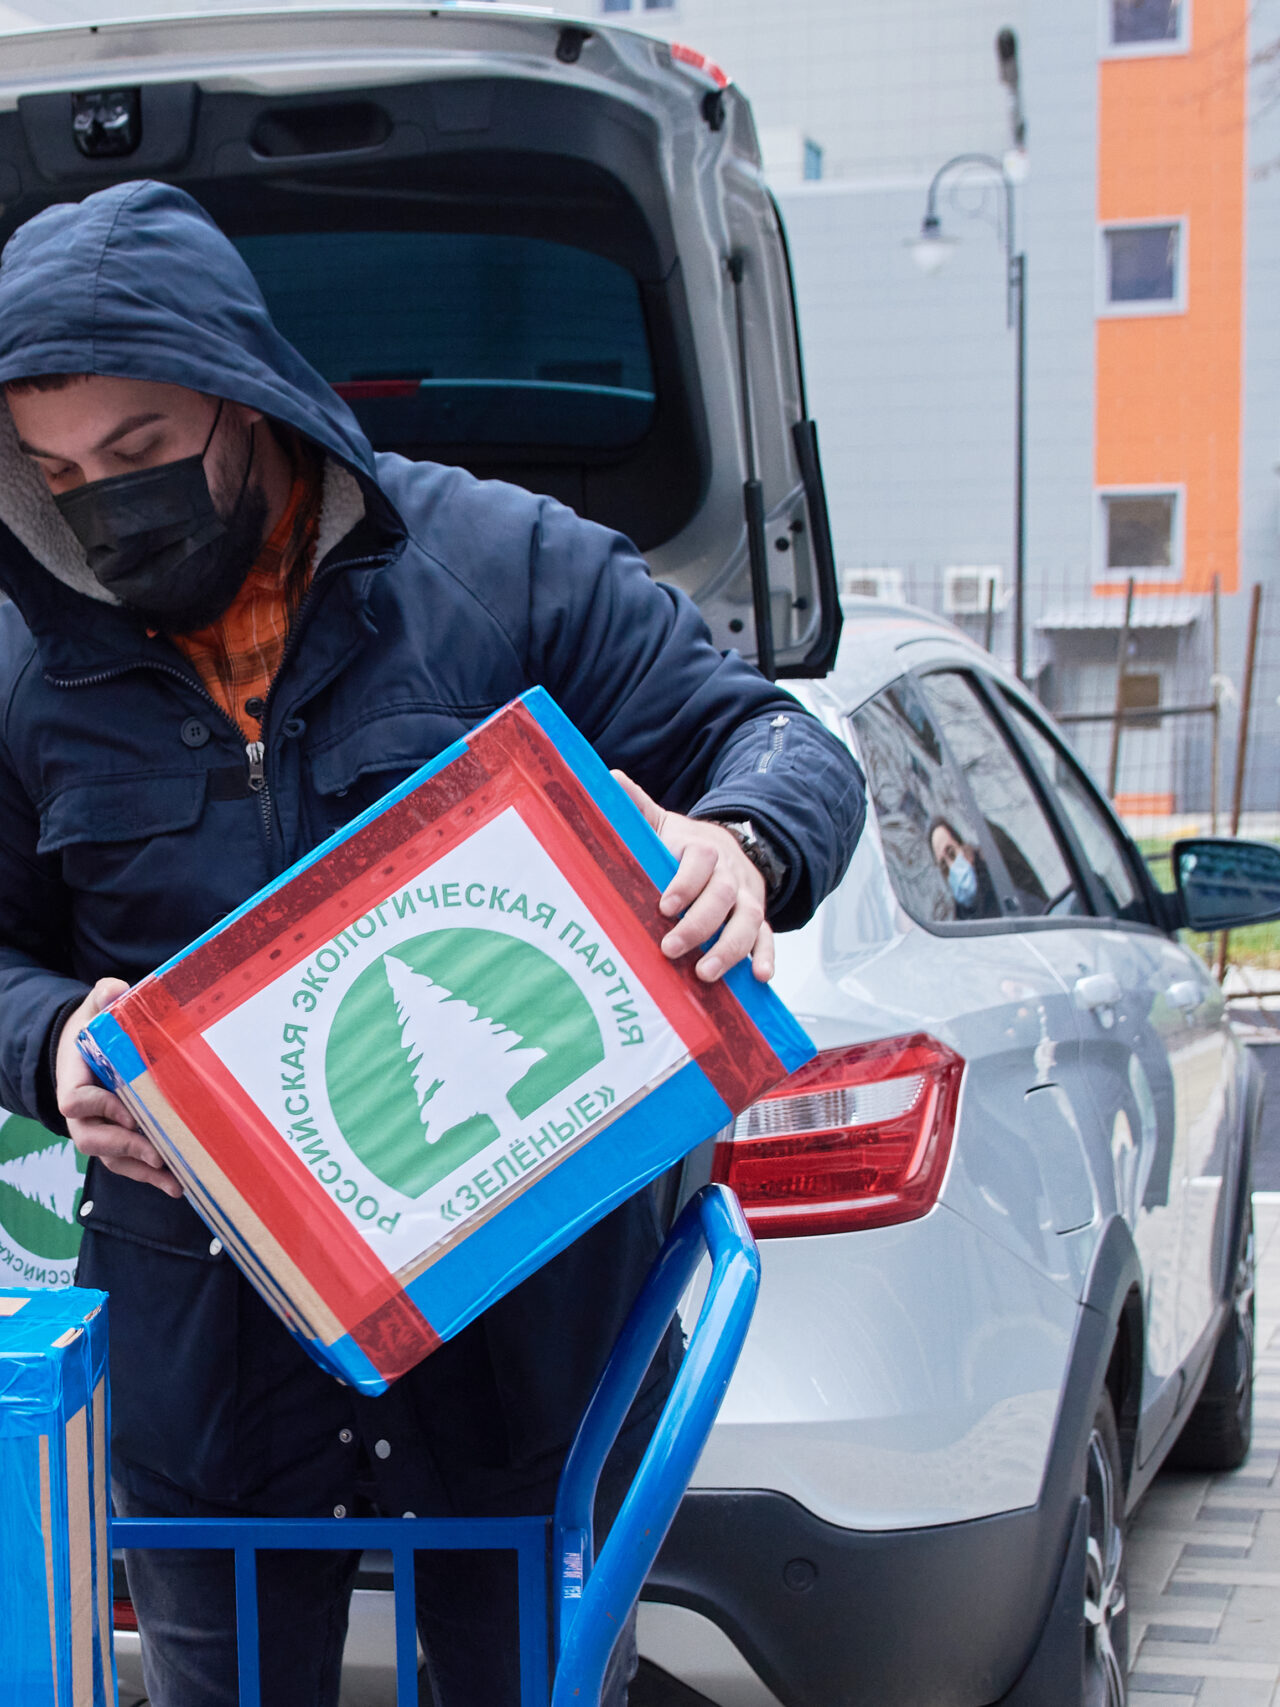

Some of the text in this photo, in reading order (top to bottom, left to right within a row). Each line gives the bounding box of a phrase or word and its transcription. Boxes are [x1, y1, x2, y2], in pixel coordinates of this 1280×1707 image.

[281, 882, 645, 1235] РОССИЙСКАЯ ЭКОЛОГИЧЕСКАЯ ПАРТИЯ
[439, 1085, 616, 1222] «ЗЕЛЁНЫЕ»
